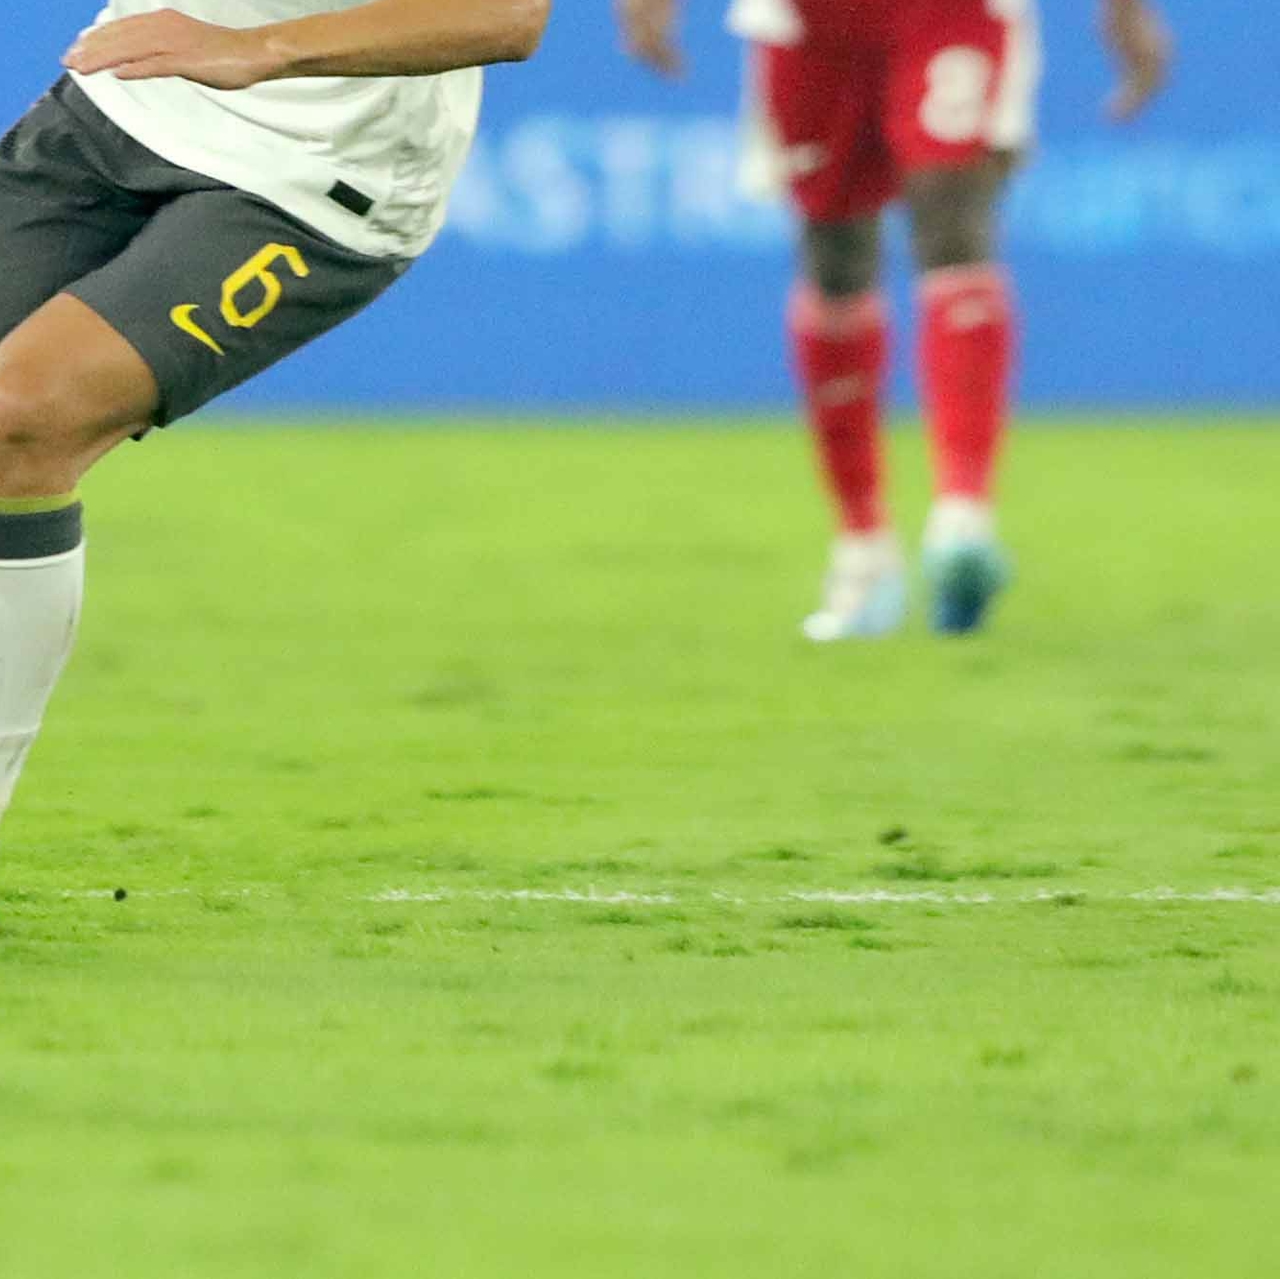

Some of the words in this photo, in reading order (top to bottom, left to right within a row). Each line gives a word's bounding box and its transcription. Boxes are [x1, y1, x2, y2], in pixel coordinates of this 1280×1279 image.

[920, 45, 993, 142] 8
[446, 115, 805, 252] STR
[221, 242, 310, 328] 6
